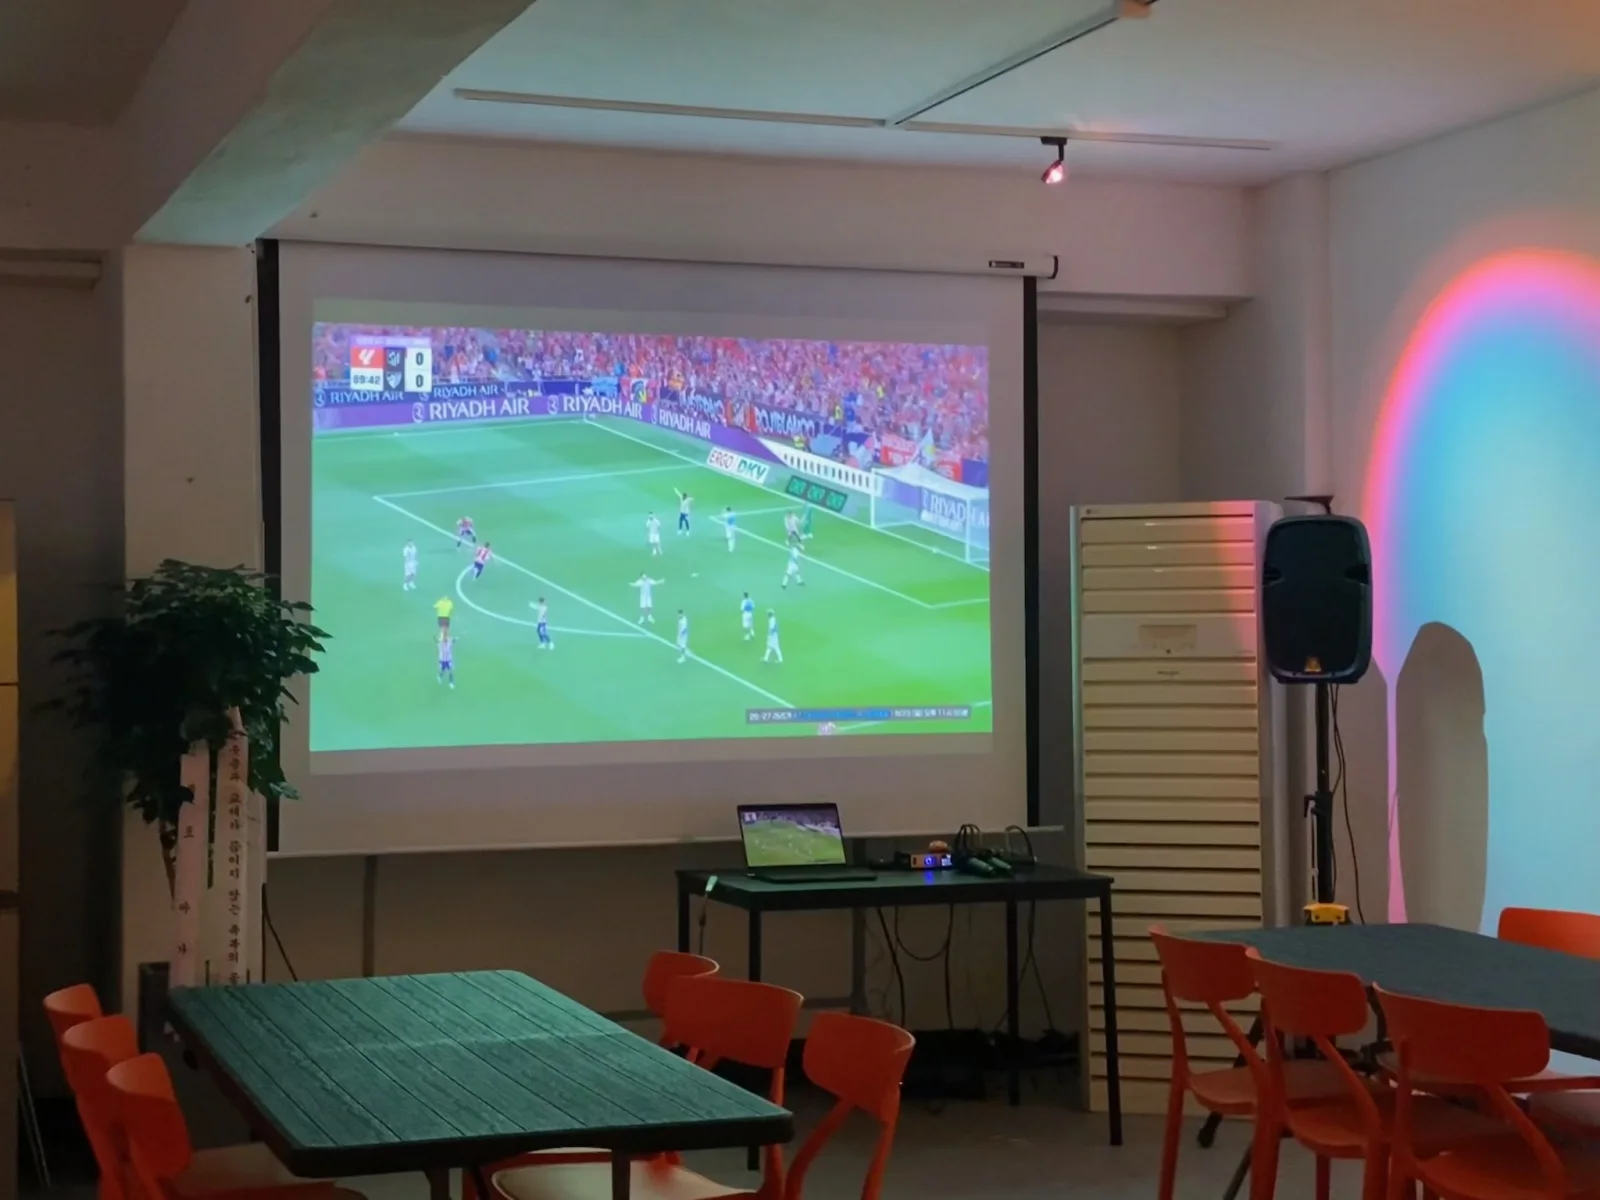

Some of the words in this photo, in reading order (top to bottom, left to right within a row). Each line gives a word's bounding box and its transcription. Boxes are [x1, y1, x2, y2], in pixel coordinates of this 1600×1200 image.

[415, 351, 425, 366] 0
[415, 374, 425, 389] 0
[434, 386, 477, 398] RIYADH
[479, 384, 499, 396] AIR
[330, 390, 380, 404] RIYADH
[429, 400, 497, 421] RIYADH
[499, 397, 530, 416] AIR
[563, 395, 622, 414] RIYADH
[624, 402, 643, 420] AIR
[659, 407, 695, 434] RIYADH
[694, 419, 712, 440] AIR
[708, 449, 735, 469] ERGO
[737, 458, 767, 481] DKV
